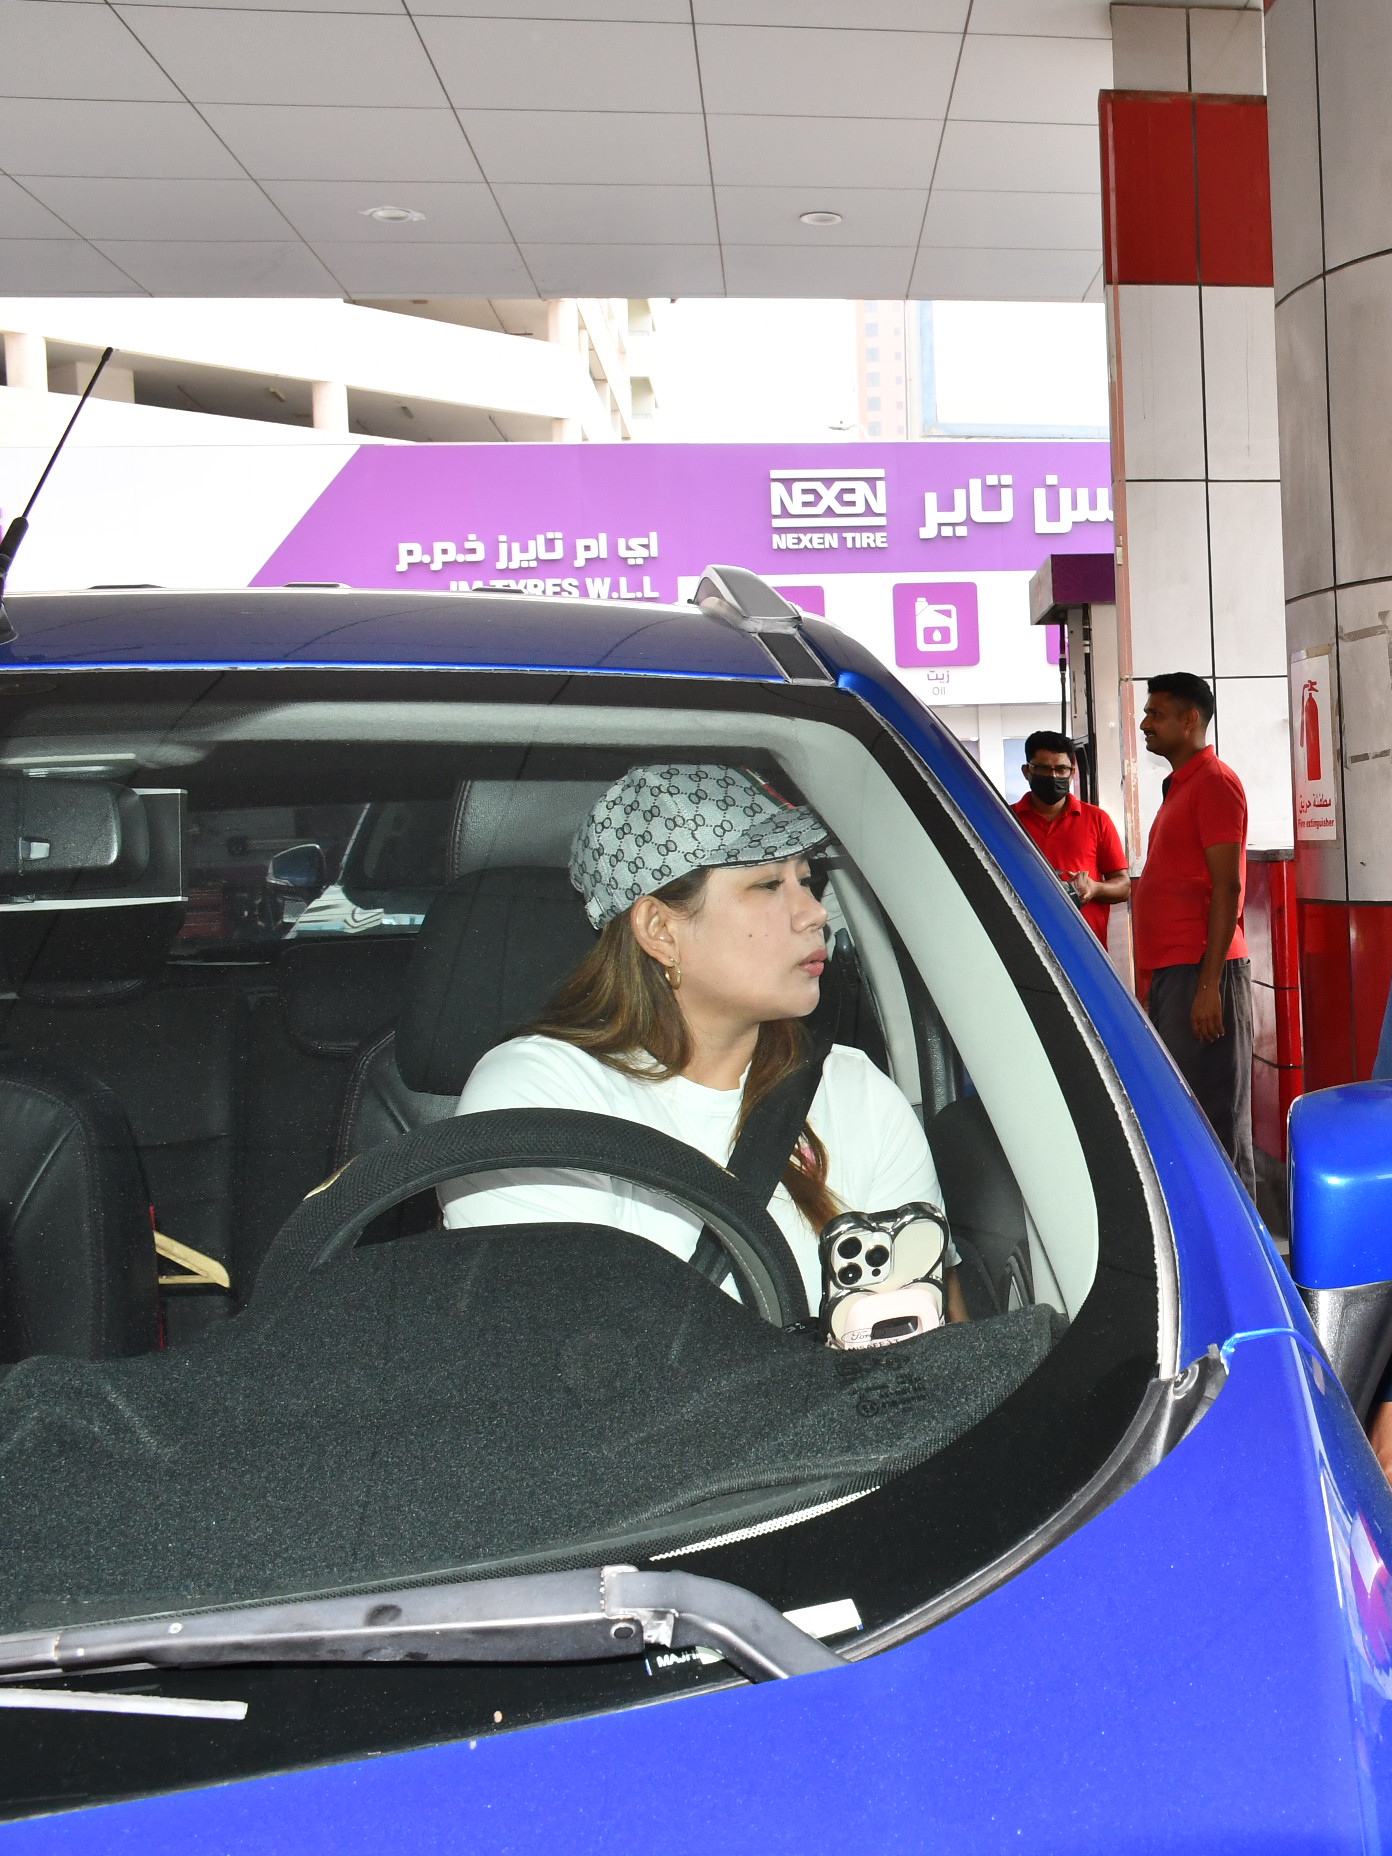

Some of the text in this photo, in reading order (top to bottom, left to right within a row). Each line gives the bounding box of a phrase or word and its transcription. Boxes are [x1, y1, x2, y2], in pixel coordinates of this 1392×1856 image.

[770, 480, 887, 515] NEXEN
[919, 474, 1013, 539] تاير
[495, 531, 563, 570] تايرز
[573, 532, 608, 568] ام
[772, 532, 888, 549] NEXEN TIRE
[927, 670, 950, 684] زيت
[932, 686, 946, 696] Oil
